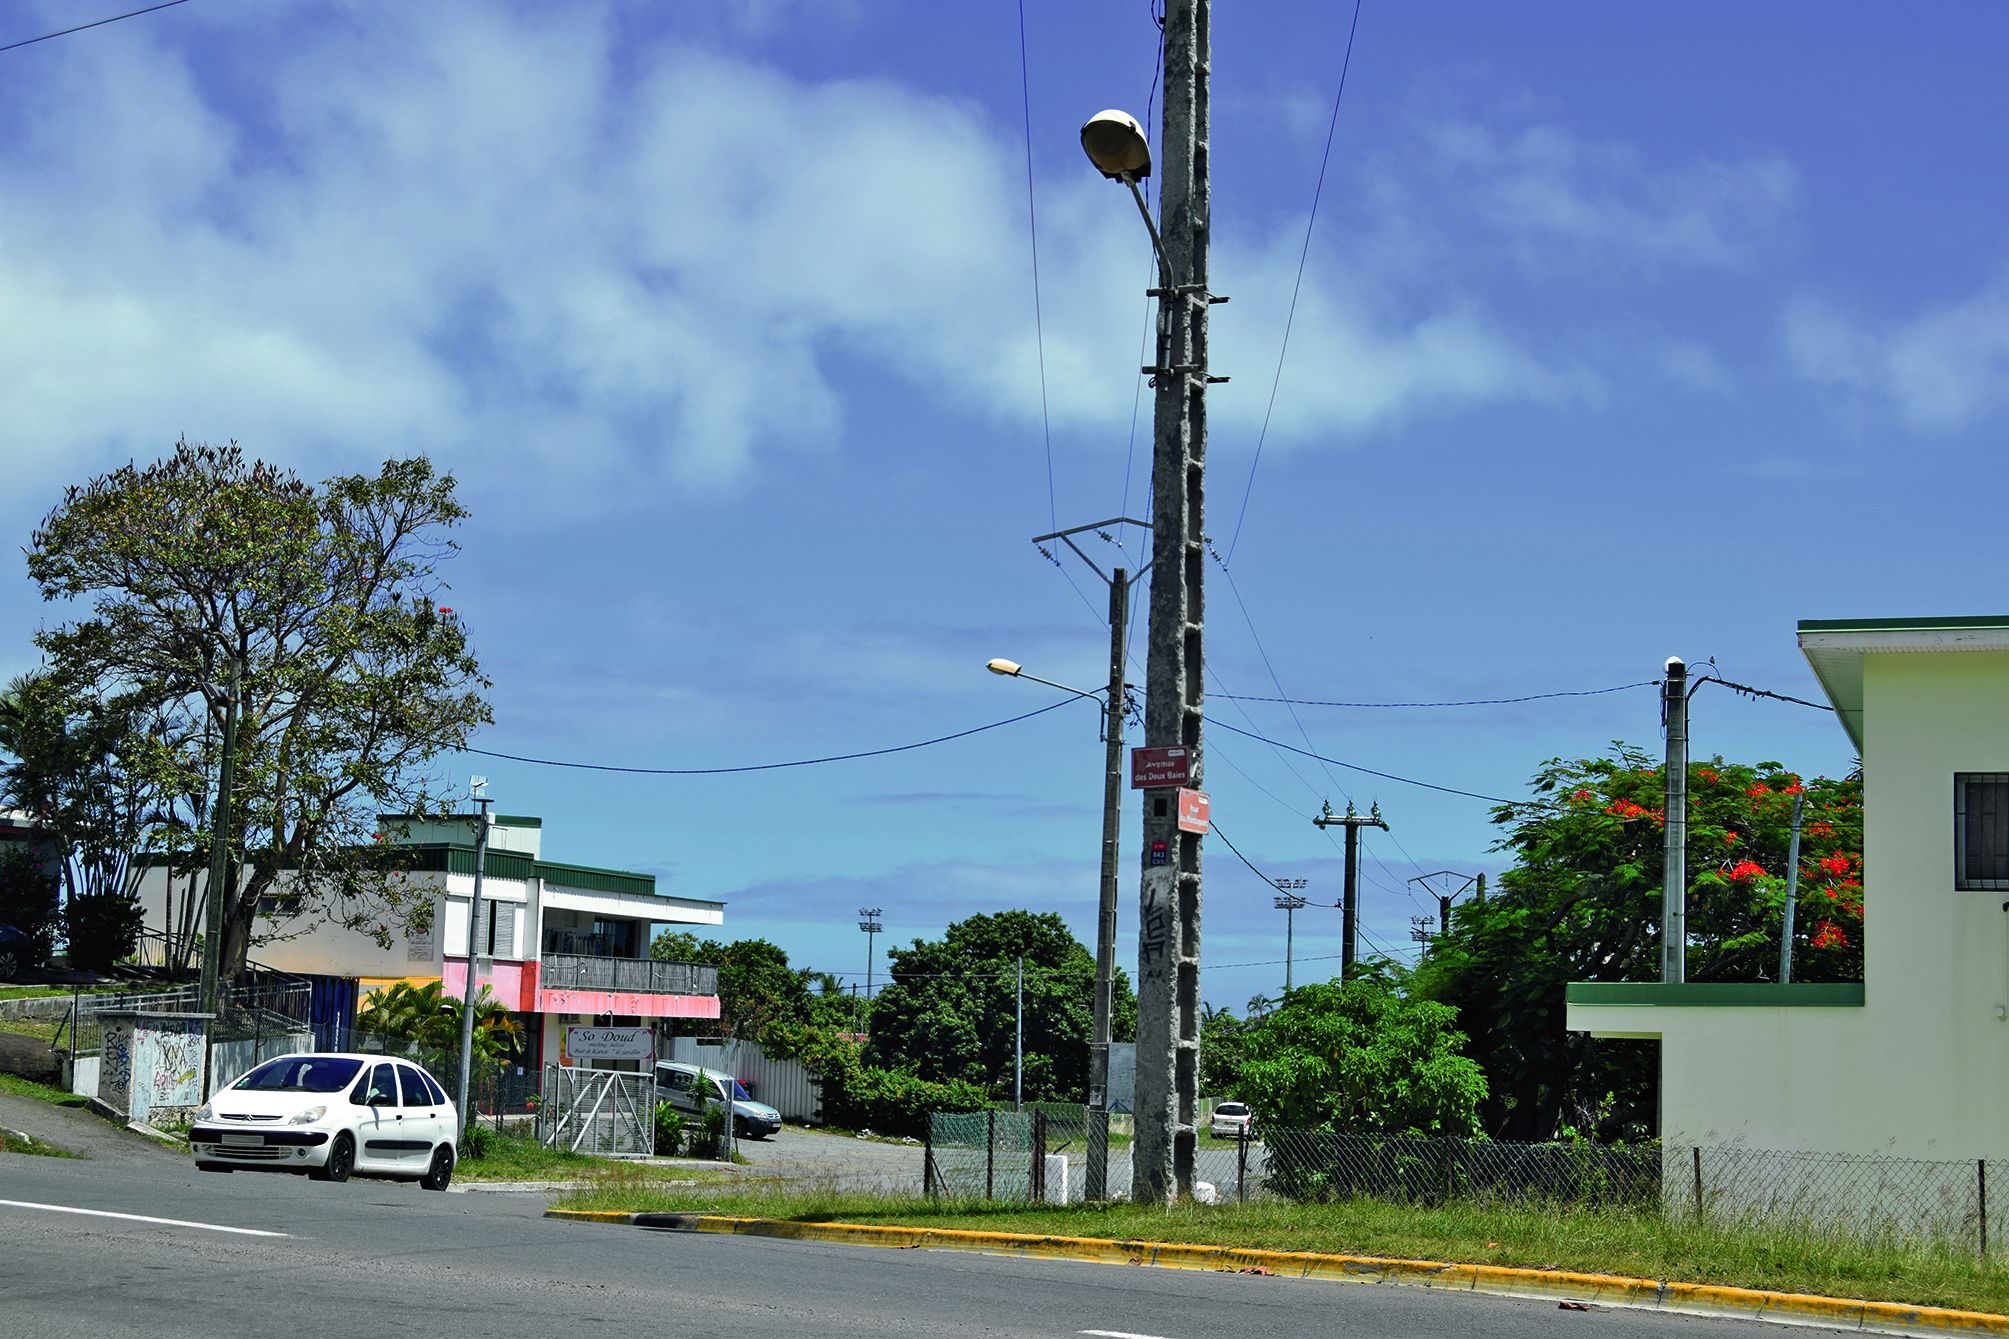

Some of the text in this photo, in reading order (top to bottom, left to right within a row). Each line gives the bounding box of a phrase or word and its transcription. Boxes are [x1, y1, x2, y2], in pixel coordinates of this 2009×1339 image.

[1134, 771, 1186, 782] des Deux Baies
